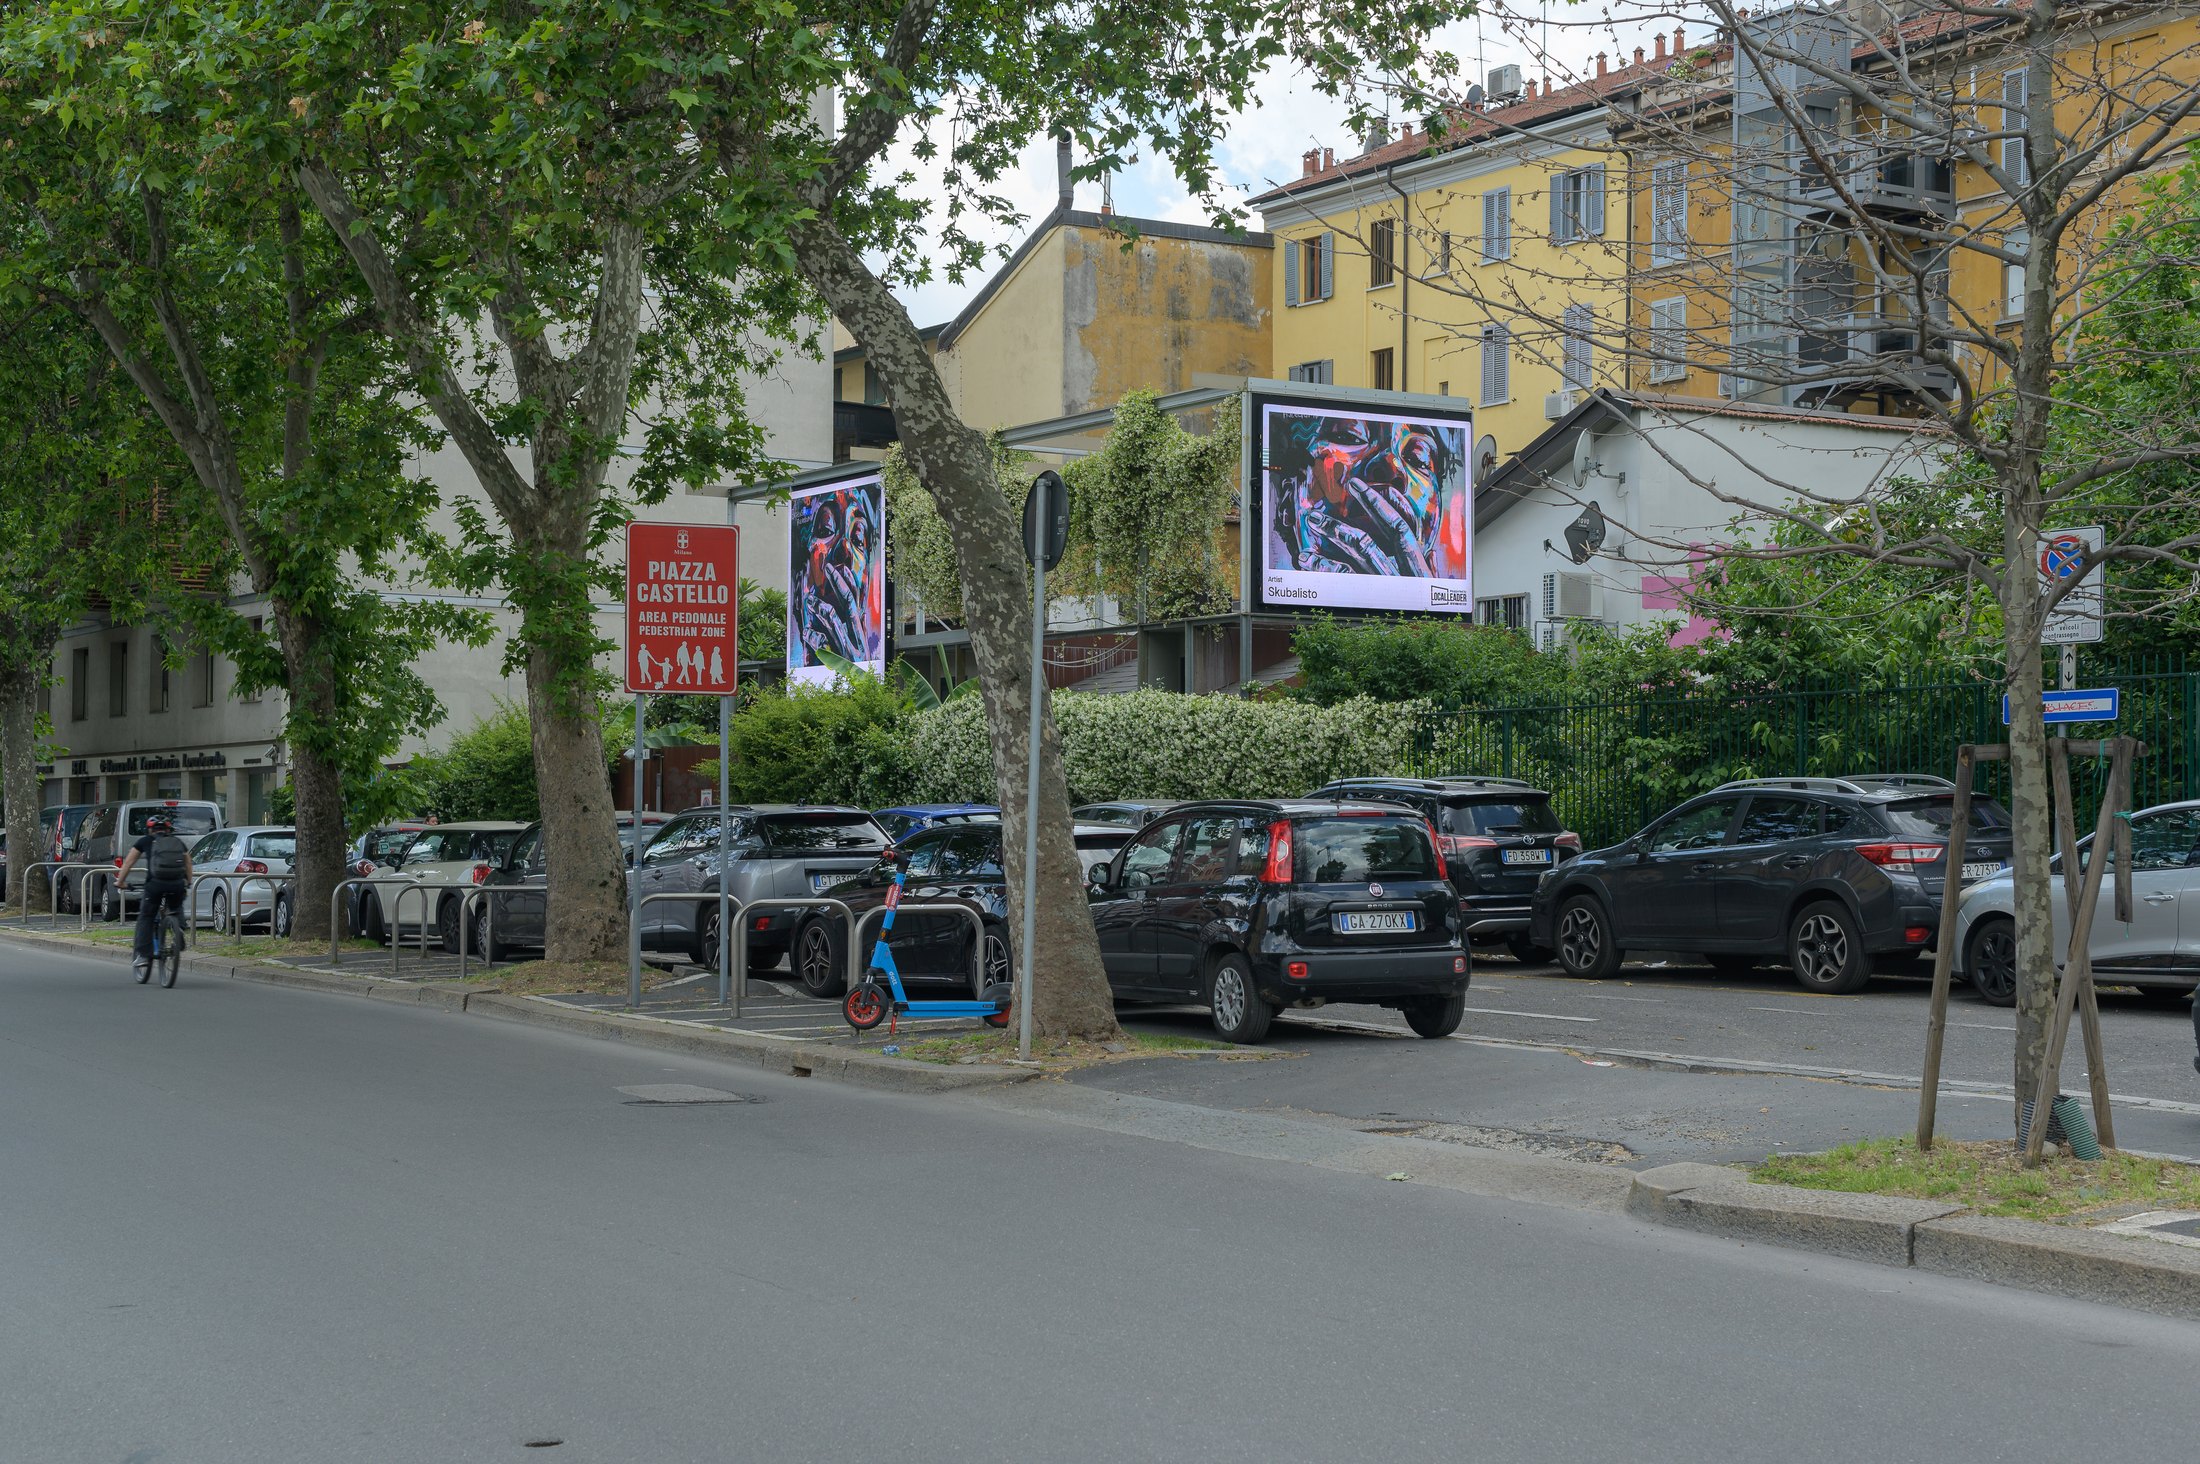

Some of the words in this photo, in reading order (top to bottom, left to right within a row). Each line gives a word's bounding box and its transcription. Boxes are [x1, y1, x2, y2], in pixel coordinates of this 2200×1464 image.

[648, 561, 717, 581] PIAZZA
[637, 583, 729, 605] CASTELLO
[1268, 586, 1318, 599] Skubalisto
[639, 611, 668, 623] AREA
[672, 612, 727, 625] PEDONALE
[639, 625, 698, 637] PEDESTRIAN
[701, 626, 726, 638] ZONE
[2059, 623, 2080, 631] veicoli
[1369, 914, 1407, 929] 270KX
[888, 971, 898, 986] dott
